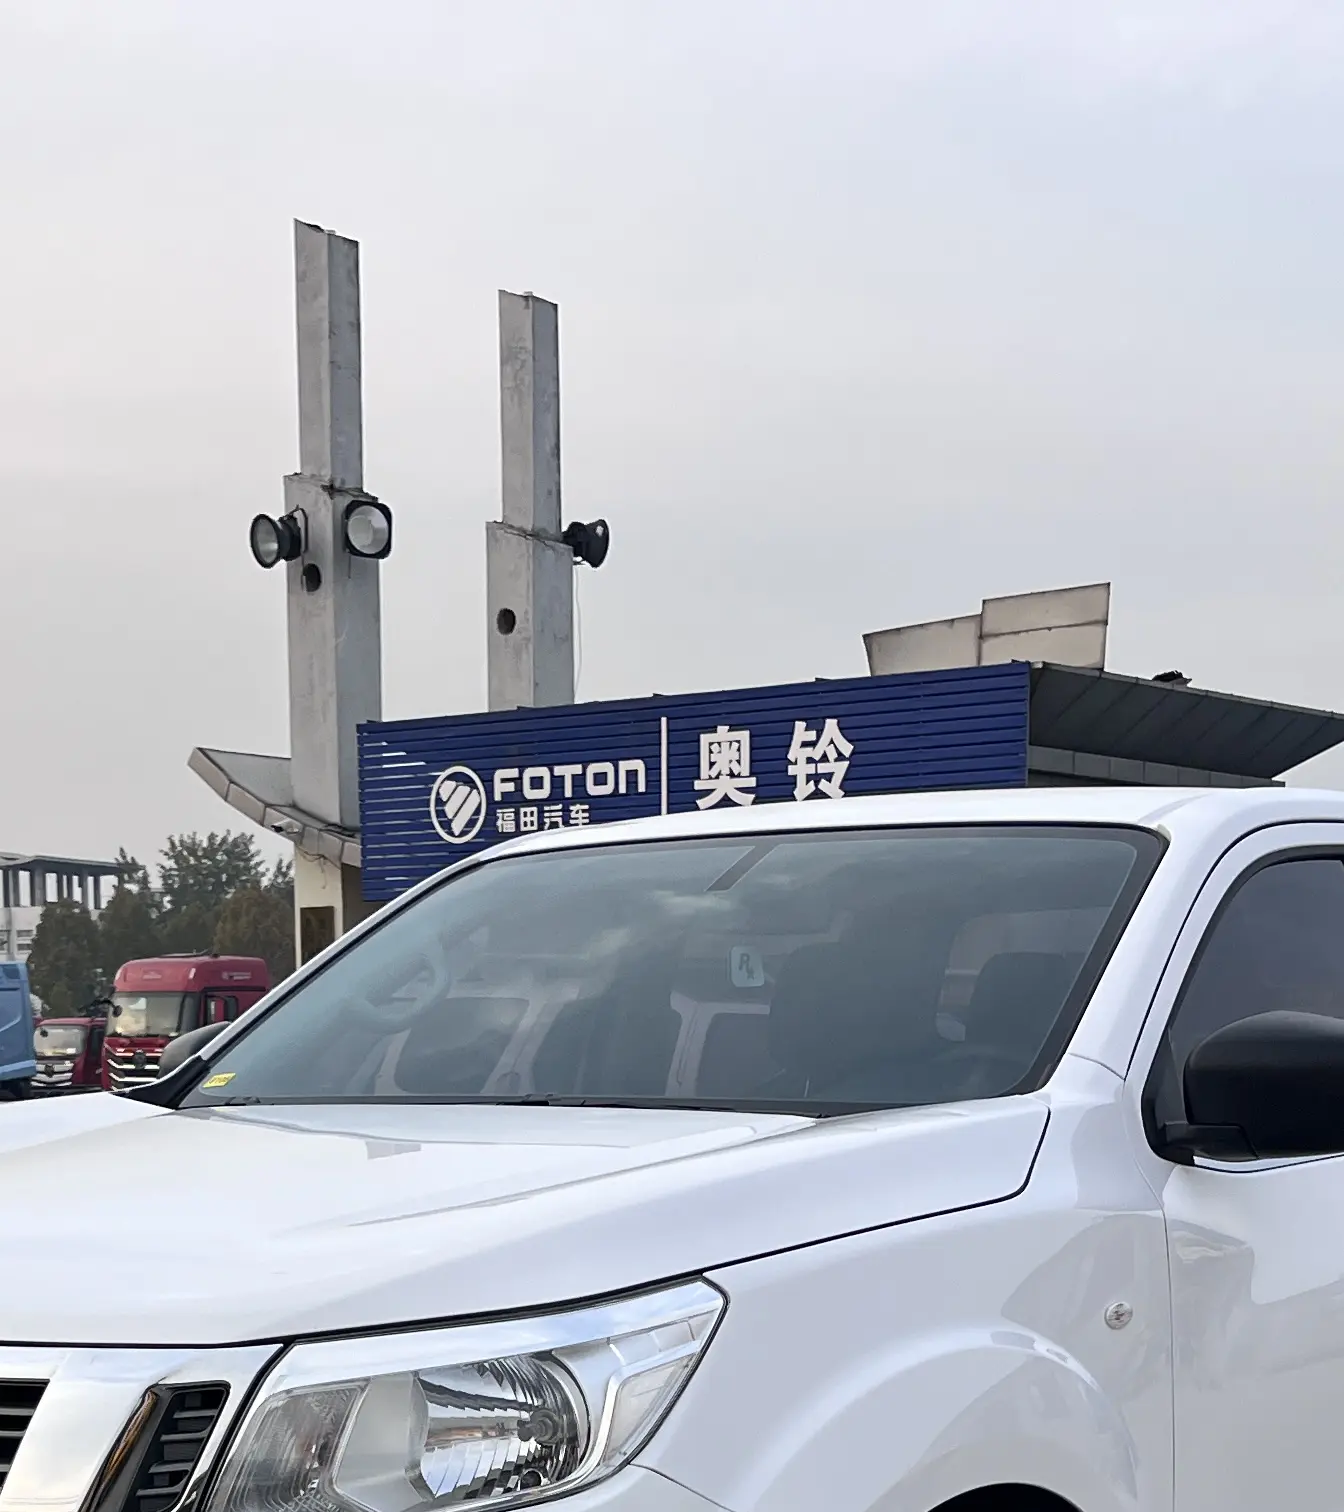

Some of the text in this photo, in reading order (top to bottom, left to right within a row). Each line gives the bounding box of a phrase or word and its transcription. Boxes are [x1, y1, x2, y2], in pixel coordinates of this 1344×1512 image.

[493, 759, 646, 801] FOTON
[694, 718, 854, 810] 奥铃
[496, 803, 592, 833] 福田汽车
